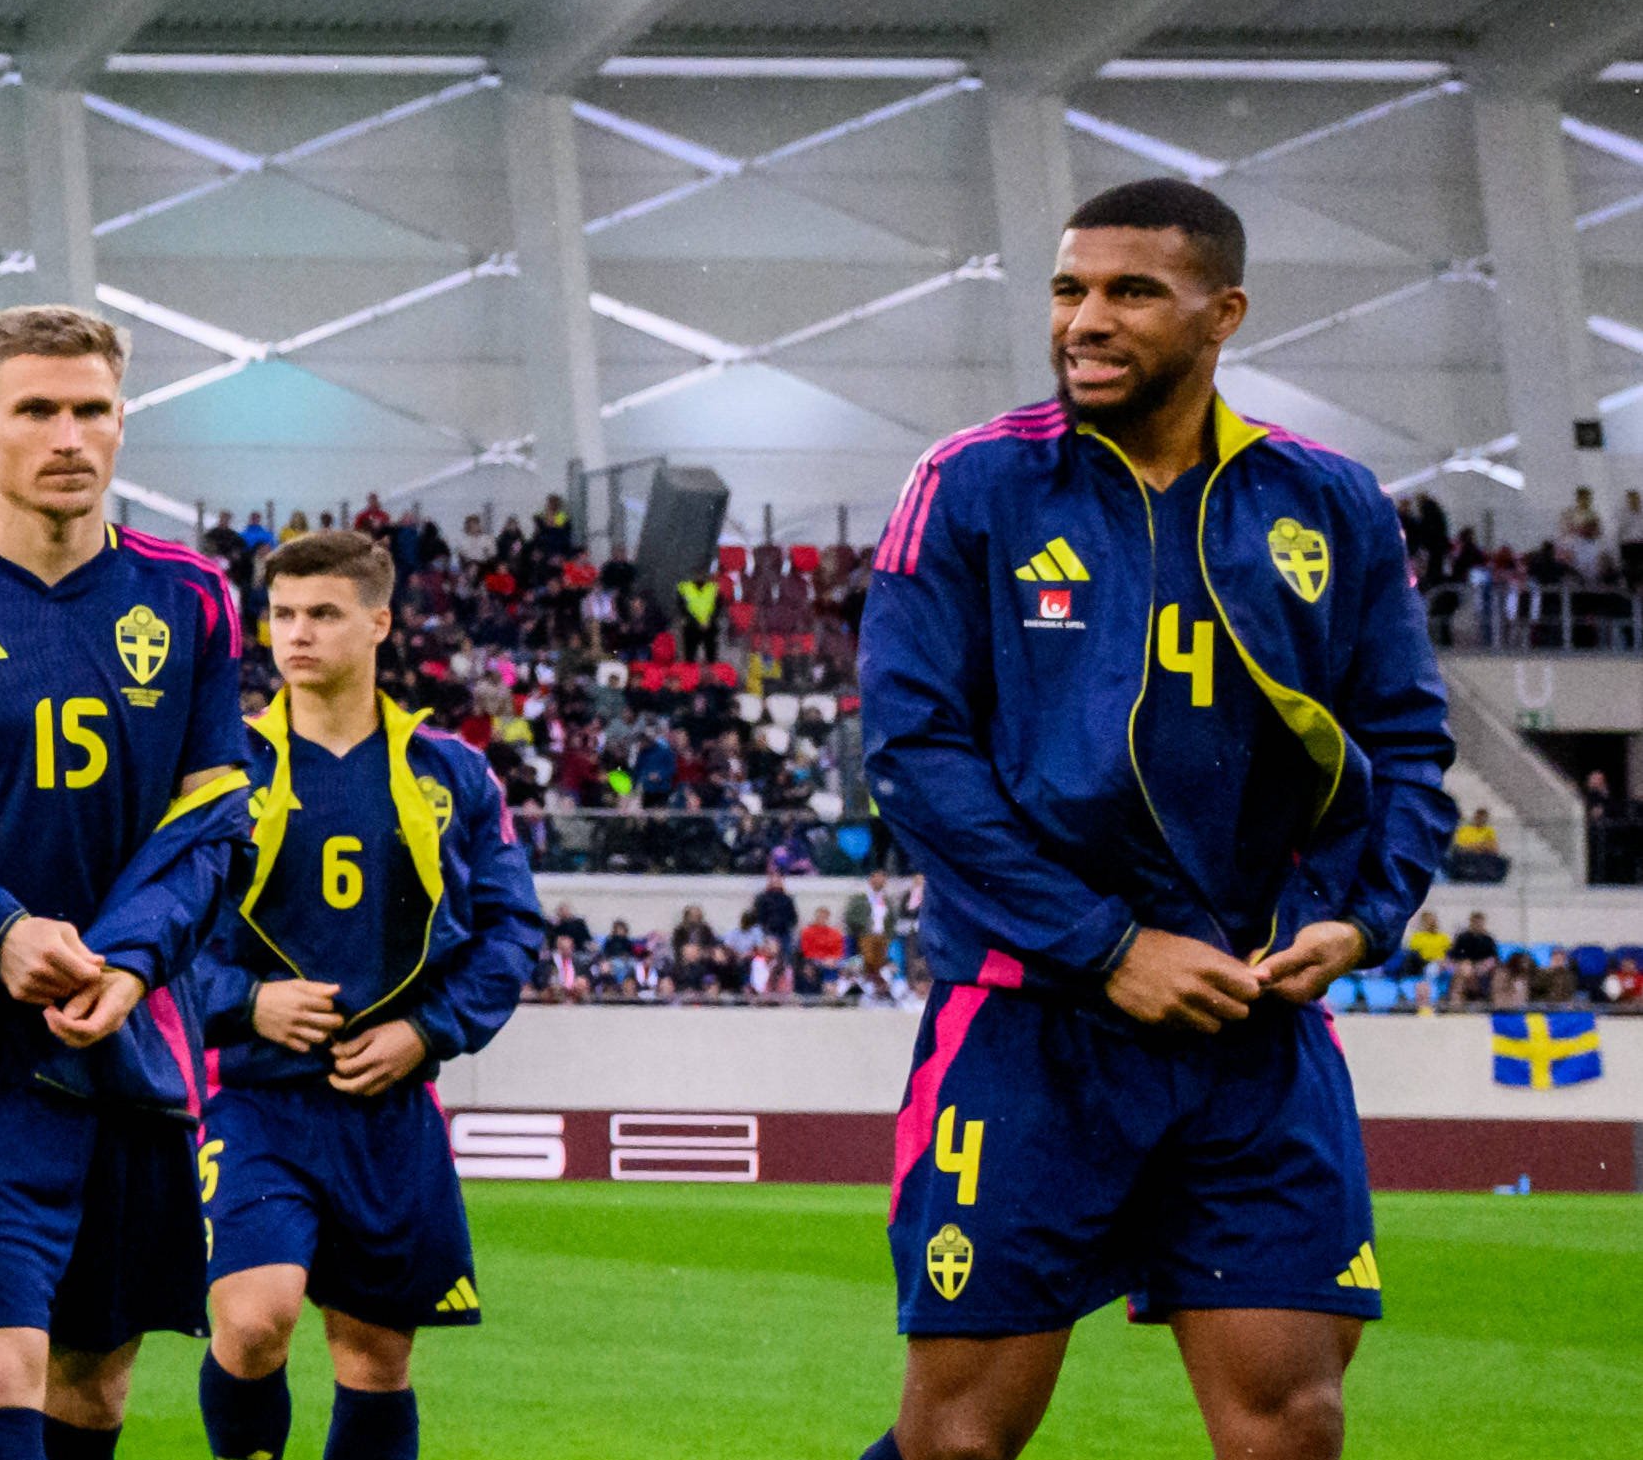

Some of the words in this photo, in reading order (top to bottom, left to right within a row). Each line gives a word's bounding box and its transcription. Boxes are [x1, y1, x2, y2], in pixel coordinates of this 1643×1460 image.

[1158, 603, 1214, 707] 4
[34, 697, 108, 789] 15
[322, 835, 363, 910] 6
[934, 1104, 985, 1206] 4
